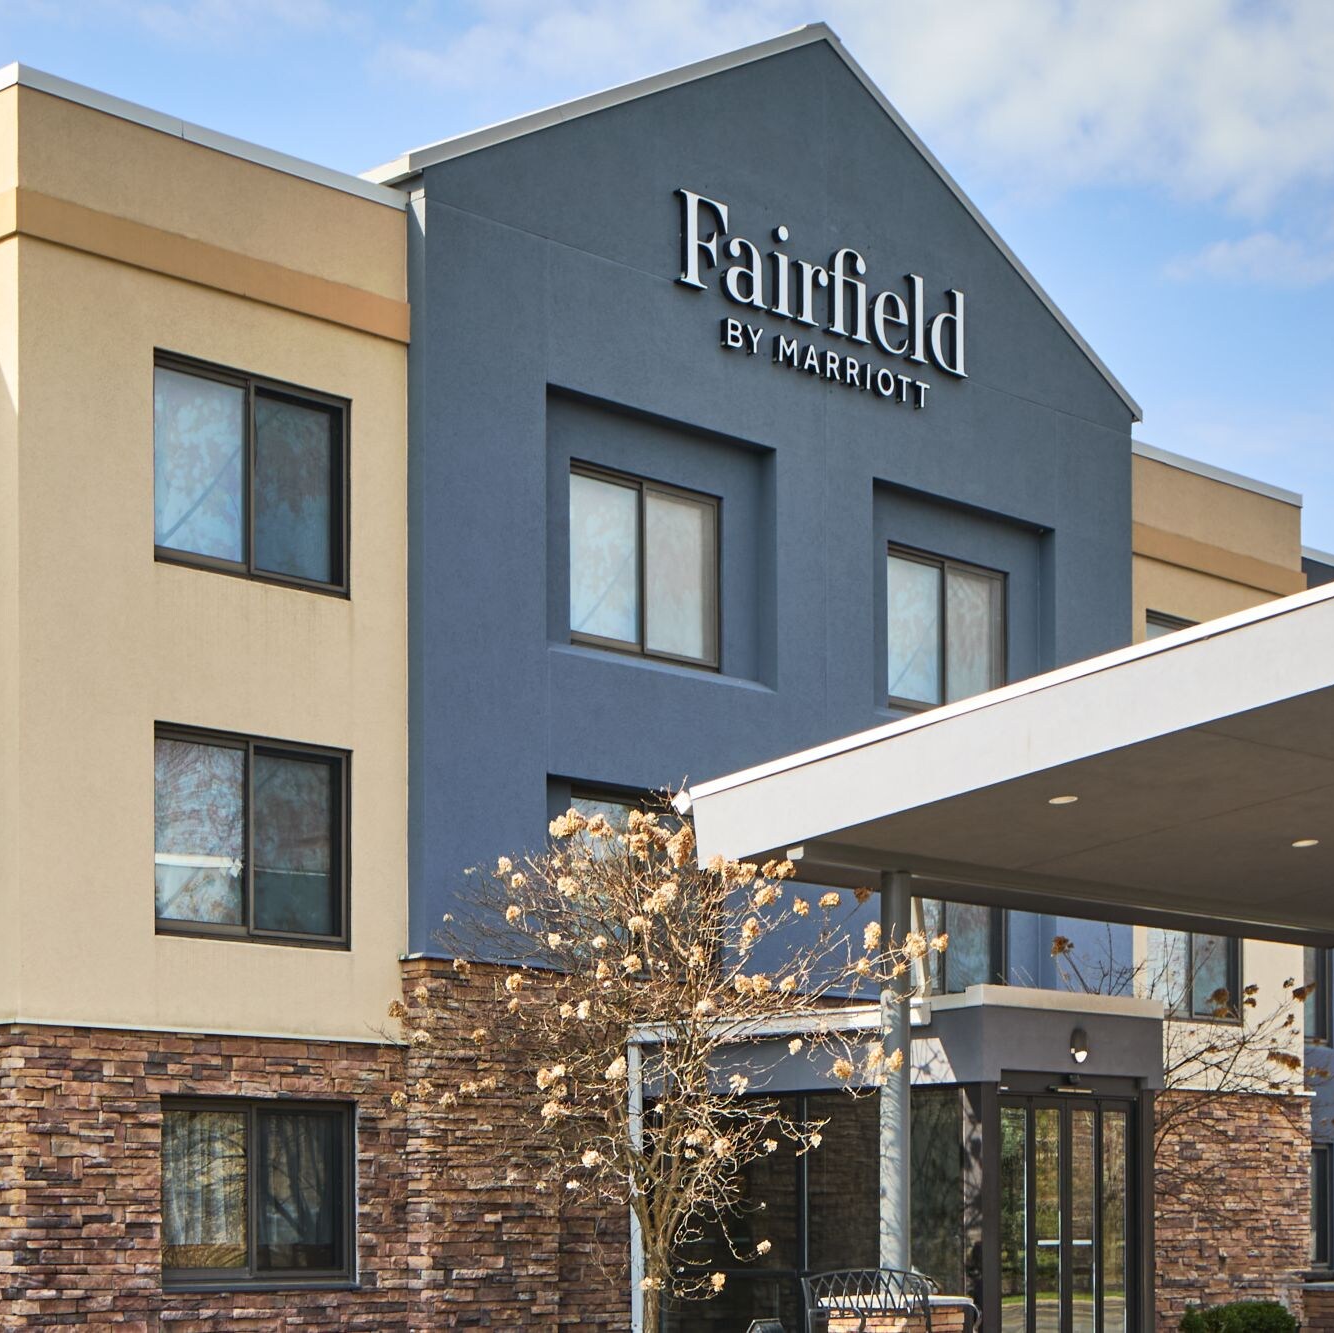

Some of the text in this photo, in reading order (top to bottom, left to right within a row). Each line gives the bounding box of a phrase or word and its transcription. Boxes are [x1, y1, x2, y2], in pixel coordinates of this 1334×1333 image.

[674, 187, 968, 379] Fairfield
[723, 317, 930, 409] BY MARRIOTT
